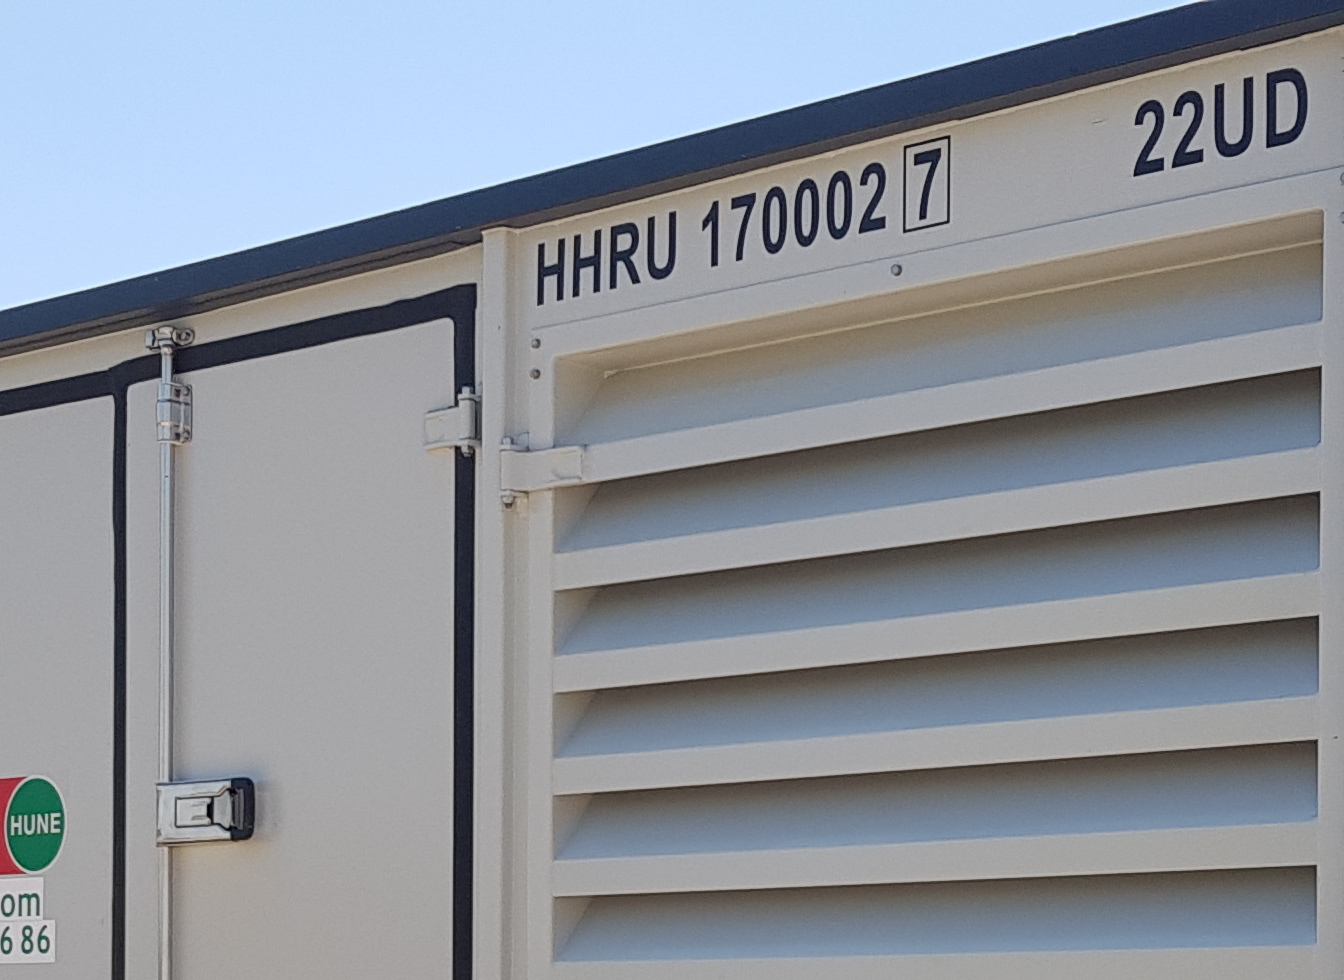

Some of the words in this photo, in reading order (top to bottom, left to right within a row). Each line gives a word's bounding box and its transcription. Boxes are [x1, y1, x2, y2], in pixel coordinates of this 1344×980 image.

[1133, 67, 1309, 177] 22UD
[536, 211, 680, 306] HHRU
[700, 160, 887, 268] 170002
[910, 143, 946, 224] 7
[10, 813, 61, 836] HUNE
[21, 924, 51, 955] 86
